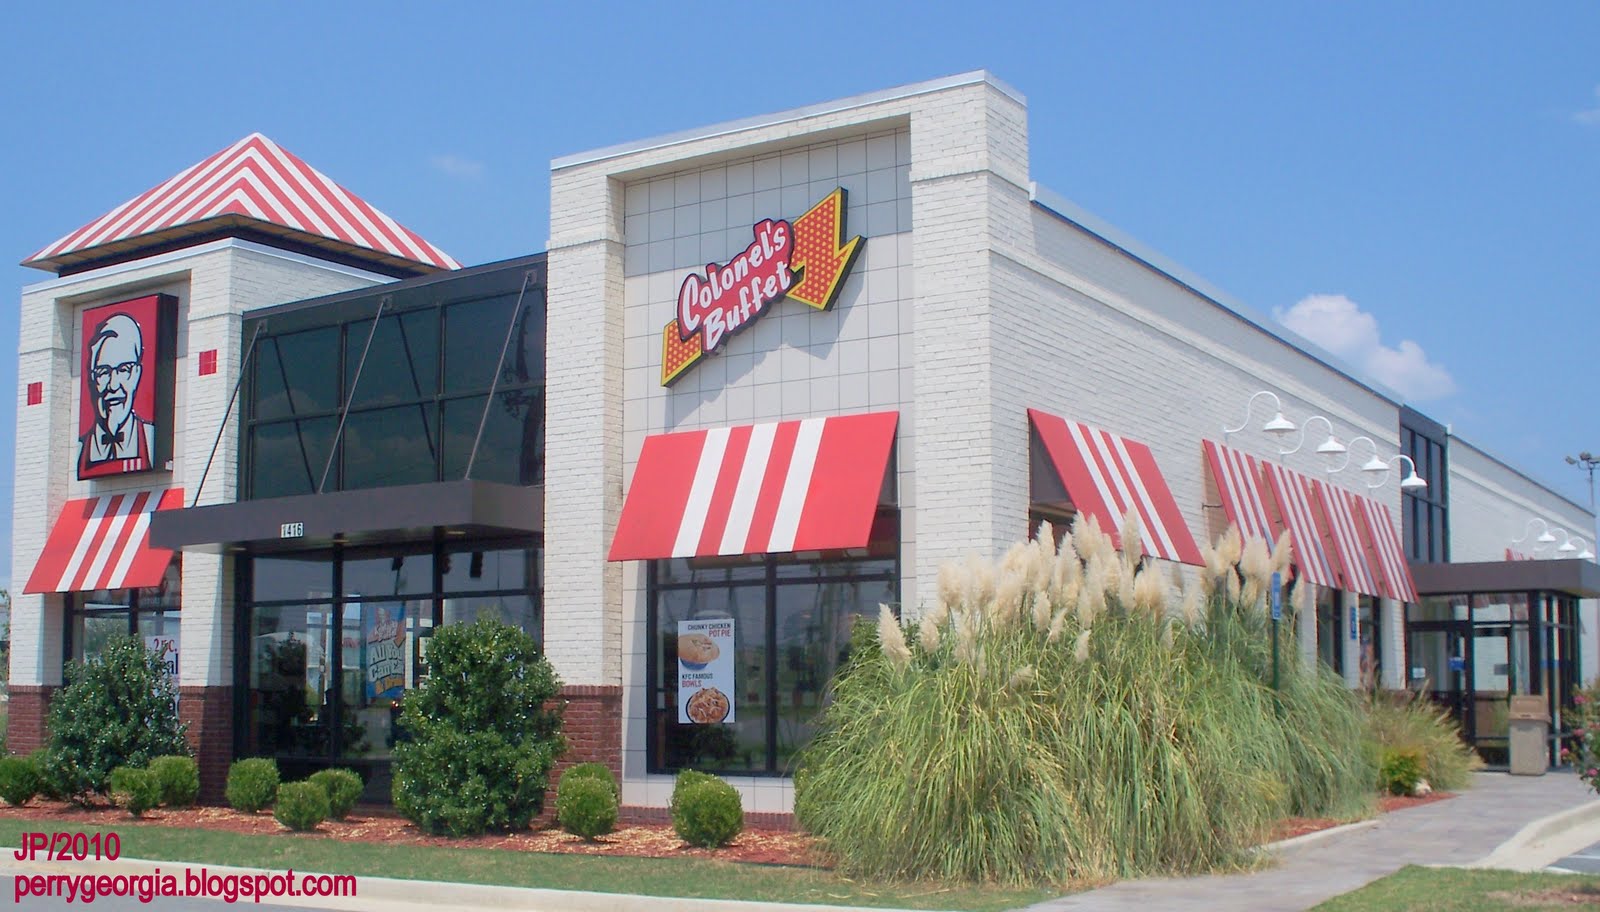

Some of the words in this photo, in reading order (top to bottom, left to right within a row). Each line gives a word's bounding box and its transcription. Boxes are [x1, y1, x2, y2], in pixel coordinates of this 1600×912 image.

[682, 222, 786, 331] Colonel's
[703, 261, 791, 350] Buffet
[281, 523, 303, 537] 1416
[709, 629, 720, 637] POT
[721, 628, 731, 637] PIE
